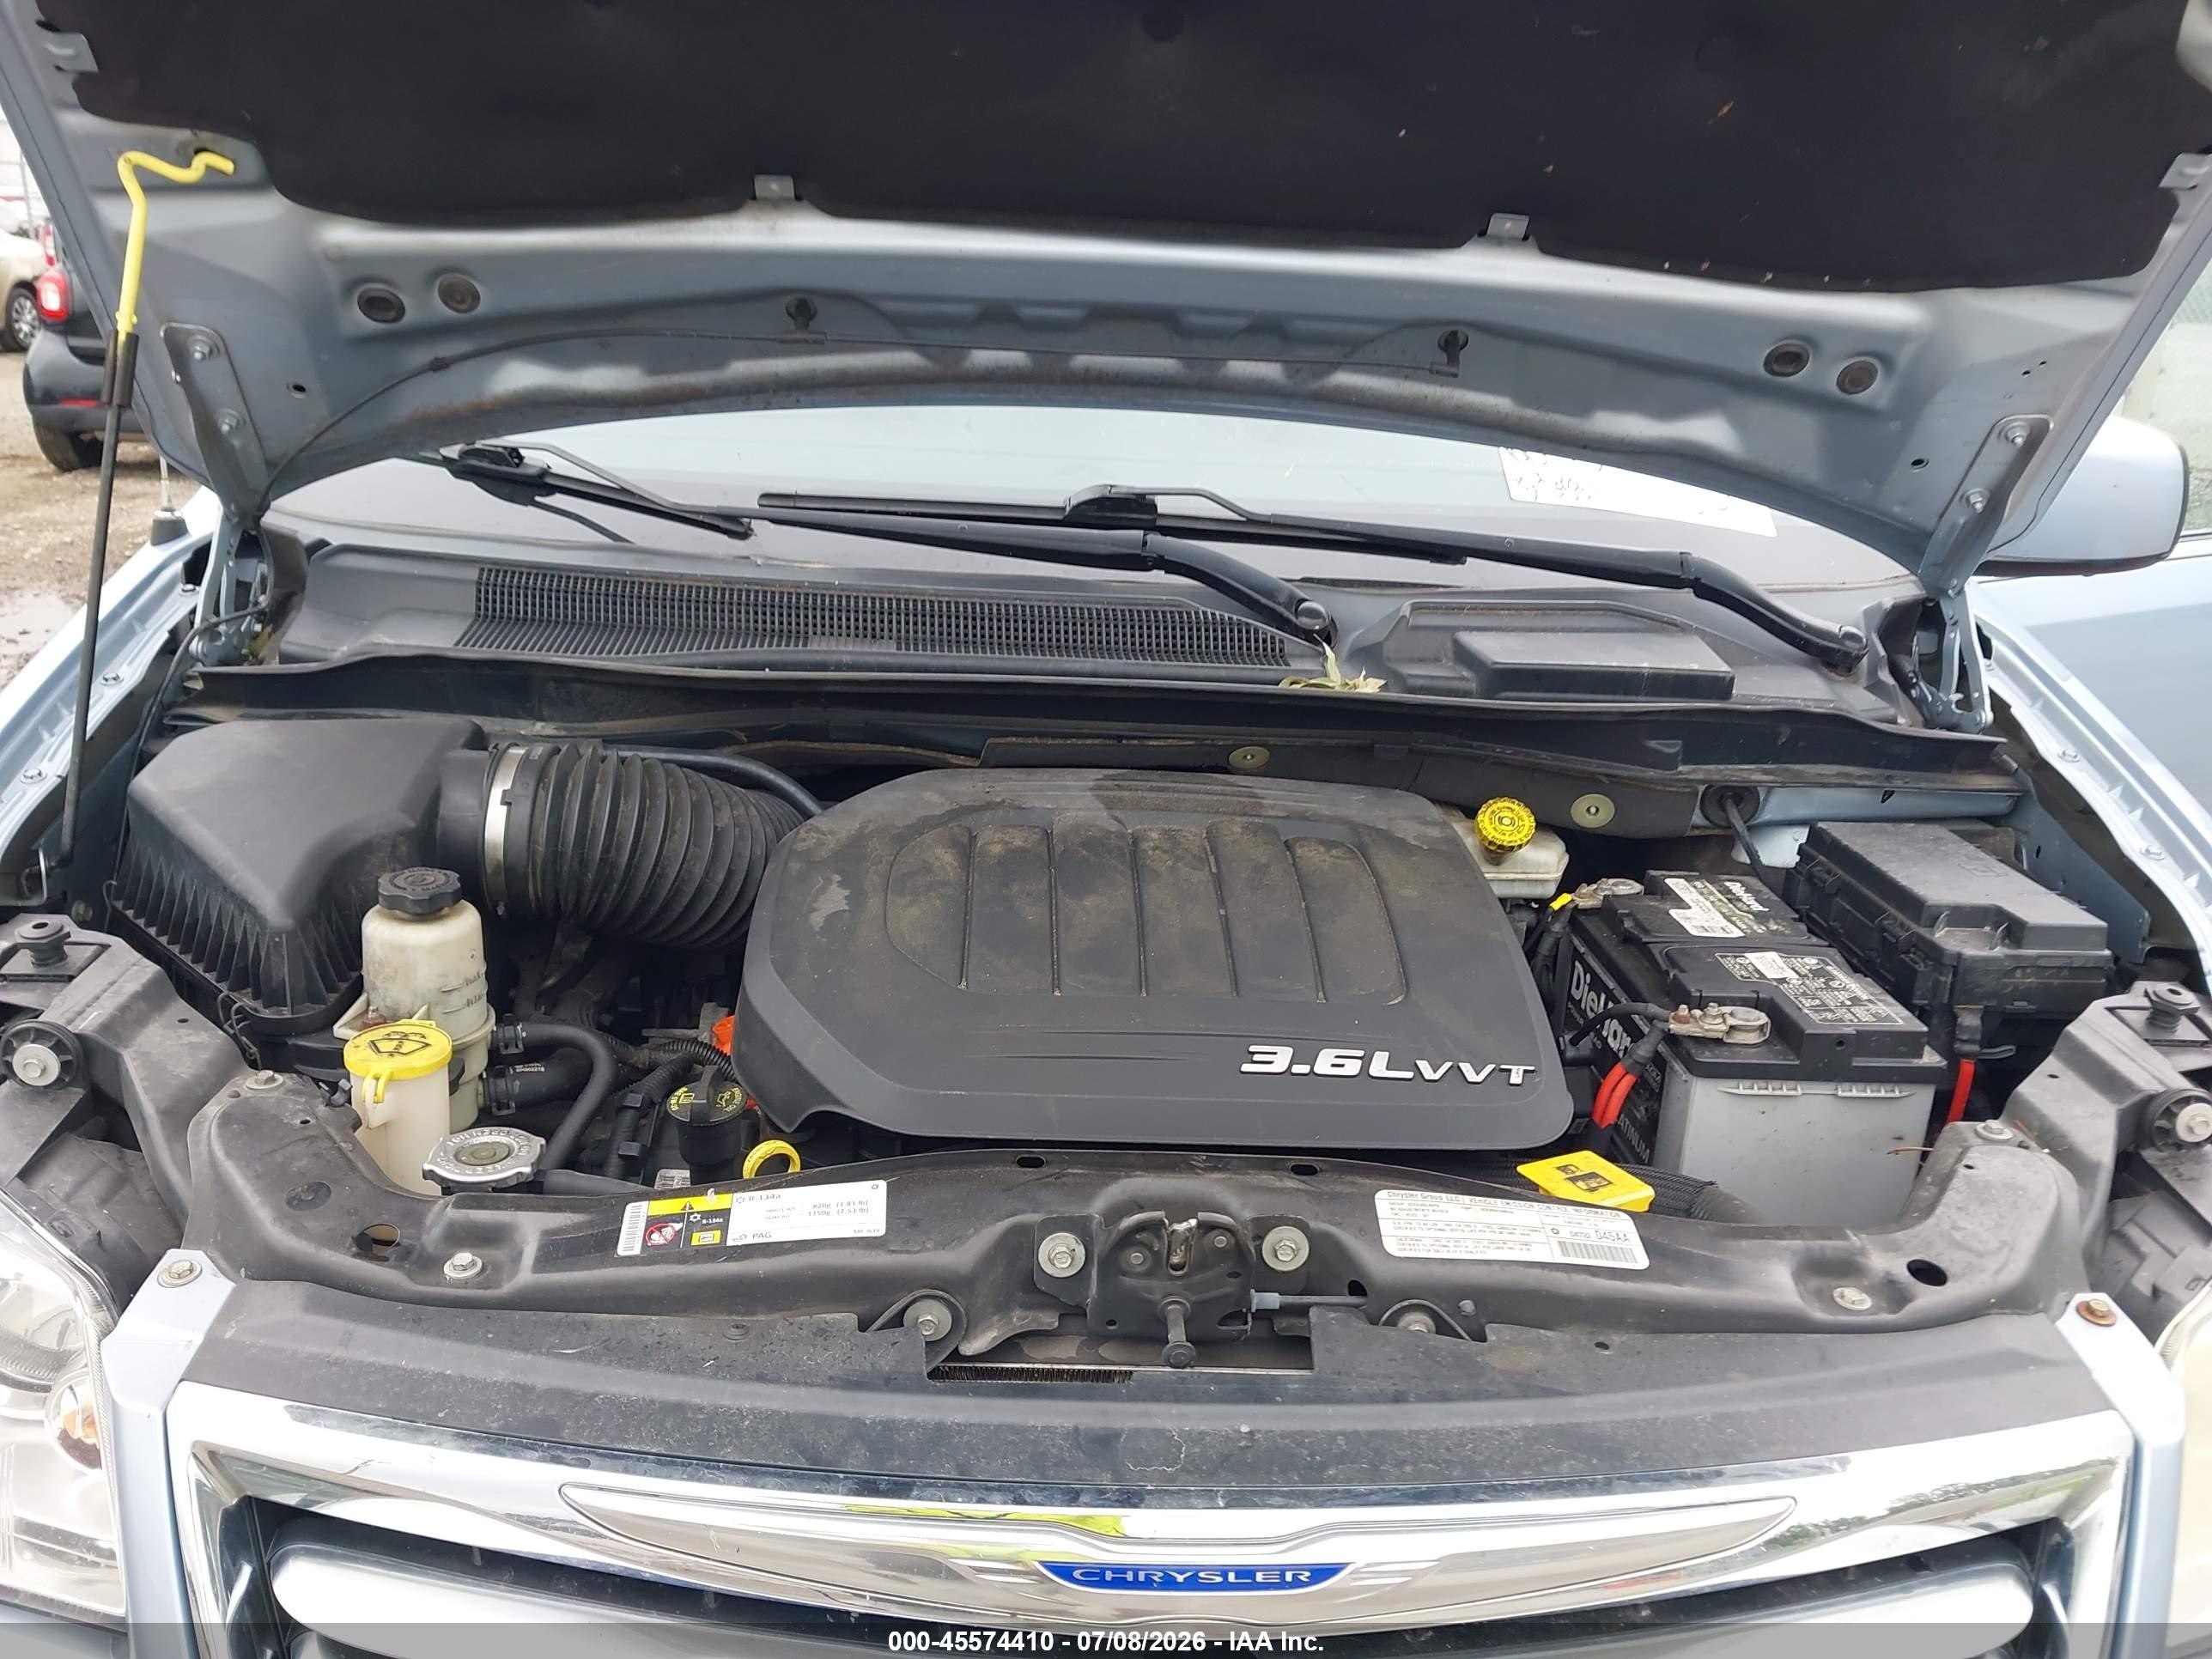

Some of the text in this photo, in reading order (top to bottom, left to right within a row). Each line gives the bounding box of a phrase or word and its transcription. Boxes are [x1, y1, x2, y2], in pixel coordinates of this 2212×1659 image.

[1724, 881, 1771, 912] DieHard
[752, 1231, 772, 1240] PAG
[1072, 1568, 1312, 1583] CHRYSLER
